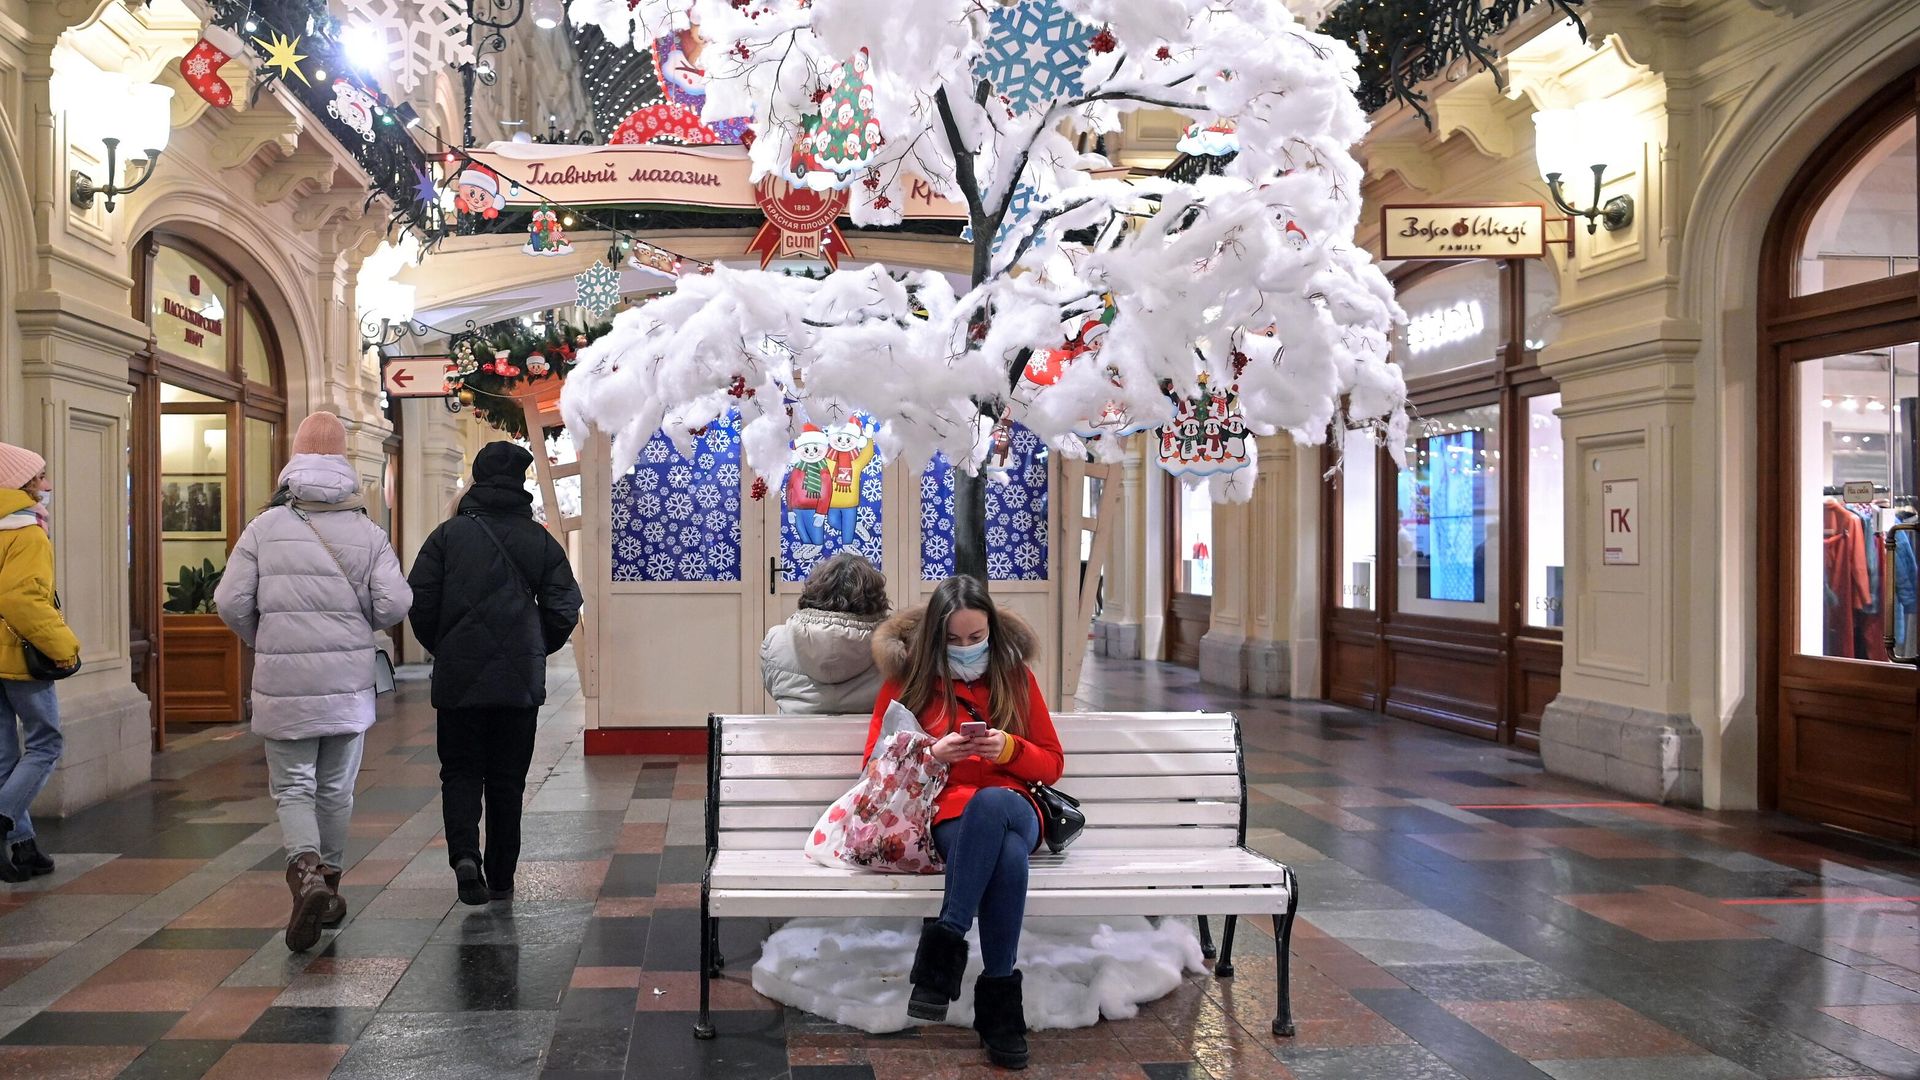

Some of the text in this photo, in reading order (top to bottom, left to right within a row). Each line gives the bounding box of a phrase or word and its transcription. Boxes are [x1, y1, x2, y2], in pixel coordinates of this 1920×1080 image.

[526, 162, 617, 185] Главный
[628, 168, 721, 187] магазин
[766, 204, 838, 230] КРАСНАЯ ПЛОЩАДЬ
[1400, 216, 1449, 242] Bosco
[786, 235, 815, 248] GUM
[164, 297, 222, 336] ПАССАЖИРСКИЙ
[1610, 508, 1631, 533] ПК
